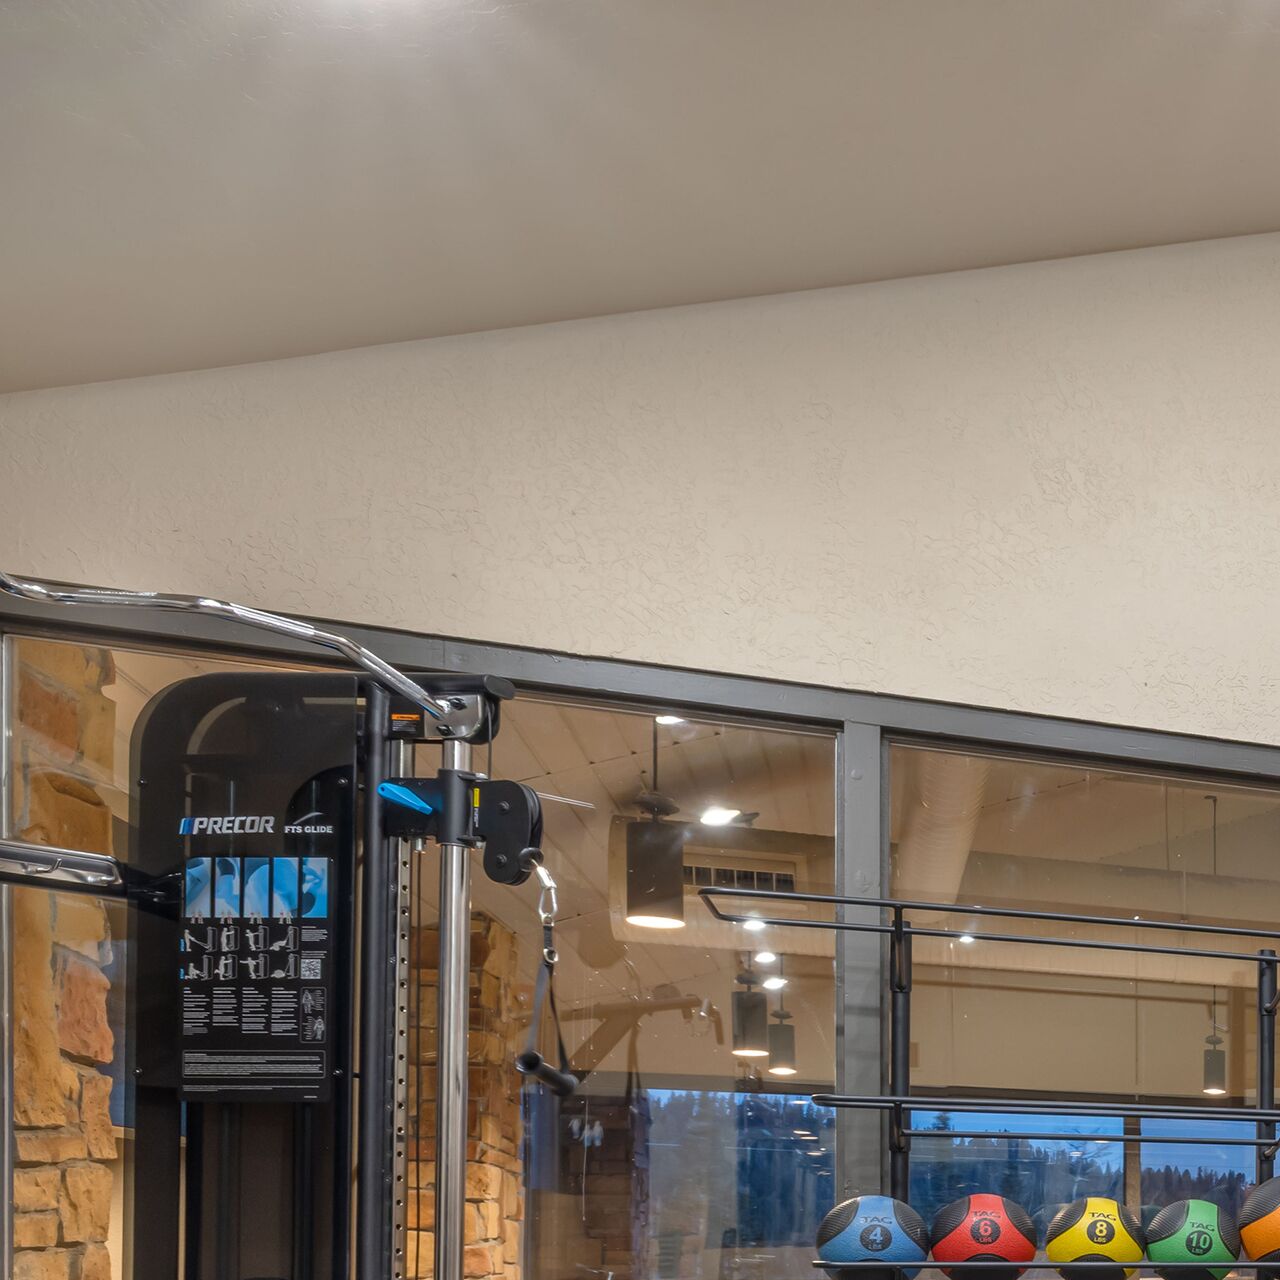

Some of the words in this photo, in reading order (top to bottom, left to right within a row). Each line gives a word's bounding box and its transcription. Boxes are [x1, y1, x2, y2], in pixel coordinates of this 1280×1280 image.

[192, 816, 275, 835] PRECOR
[284, 825, 302, 834] FTS
[304, 825, 333, 834] GLIDE
[860, 1216, 892, 1225] TAG
[970, 1210, 1001, 1219] TAG
[1088, 1211, 1116, 1221] TAG
[980, 1221, 992, 1236] 6
[1095, 1222, 1107, 1237] 8
[1189, 1222, 1215, 1231] TAG
[869, 1227, 883, 1243] 4
[1190, 1233, 1210, 1249] 10
